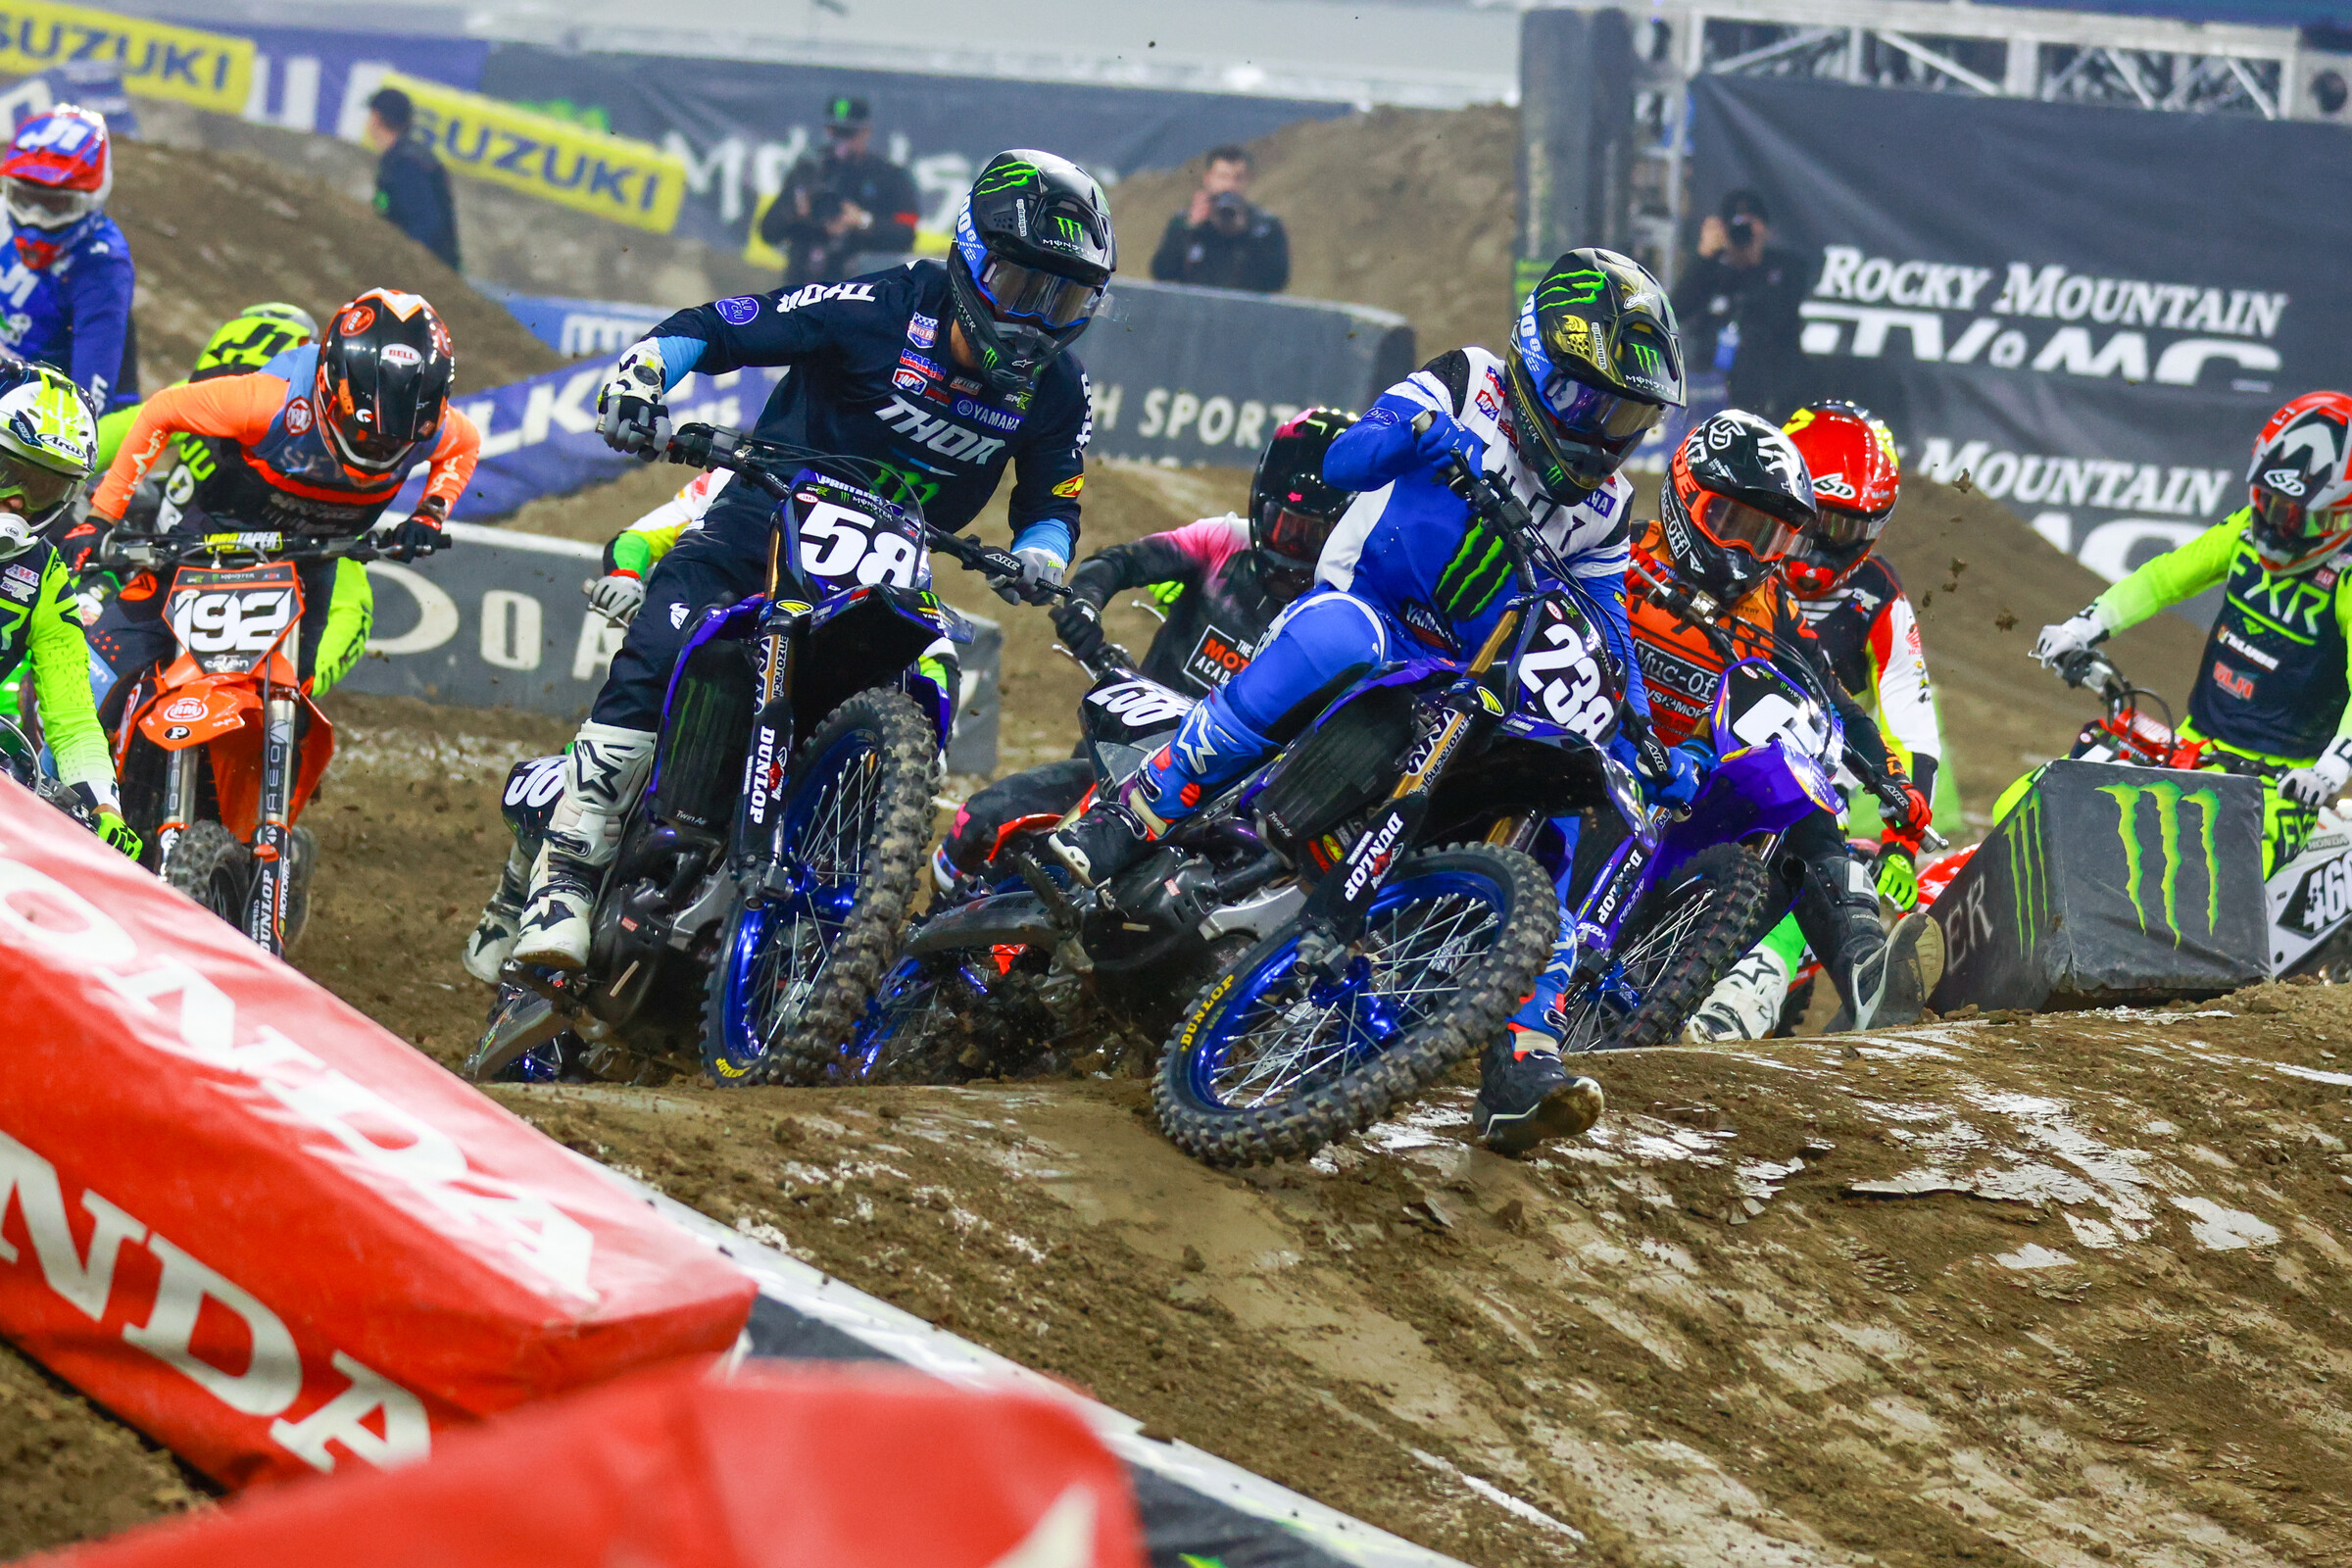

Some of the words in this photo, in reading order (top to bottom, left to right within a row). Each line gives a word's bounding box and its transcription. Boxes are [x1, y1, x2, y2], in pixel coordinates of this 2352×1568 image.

[0, 13, 231, 93] UZUKI
[1042, 238, 1100, 264] MONSTER
[1814, 244, 1993, 311] ROCKY
[1992, 261, 2289, 338] MOUNTAIN
[388, 349, 416, 361] BELL
[896, 372, 923, 391] 100%
[1625, 374, 1679, 396] MONSTER
[40, 434, 84, 458] Arai
[875, 393, 1006, 466] THOR
[973, 405, 1021, 431] YAMAHA
[1917, 436, 2232, 517] MOUNTAIN
[852, 495, 893, 521] MONSTER
[799, 500, 918, 589] 58
[984, 552, 1021, 571] ARC
[2227, 540, 2330, 636] FXR
[172, 586, 294, 653] 192
[1235, 639, 1254, 658] THE
[1518, 623, 1615, 742] 238
[1637, 645, 1718, 700] Muc-Of
[749, 725, 775, 824] DUNLOP
[1643, 739, 1668, 772] ARC
[1882, 783, 1909, 808] ARC
[1344, 811, 1404, 902] DUNLOP
[2306, 833, 2349, 852] HONDA
[261, 869, 274, 953] DUNLOP
[279, 857, 291, 920] MOTOREX
[1180, 973, 1235, 1048] DUNLOP
